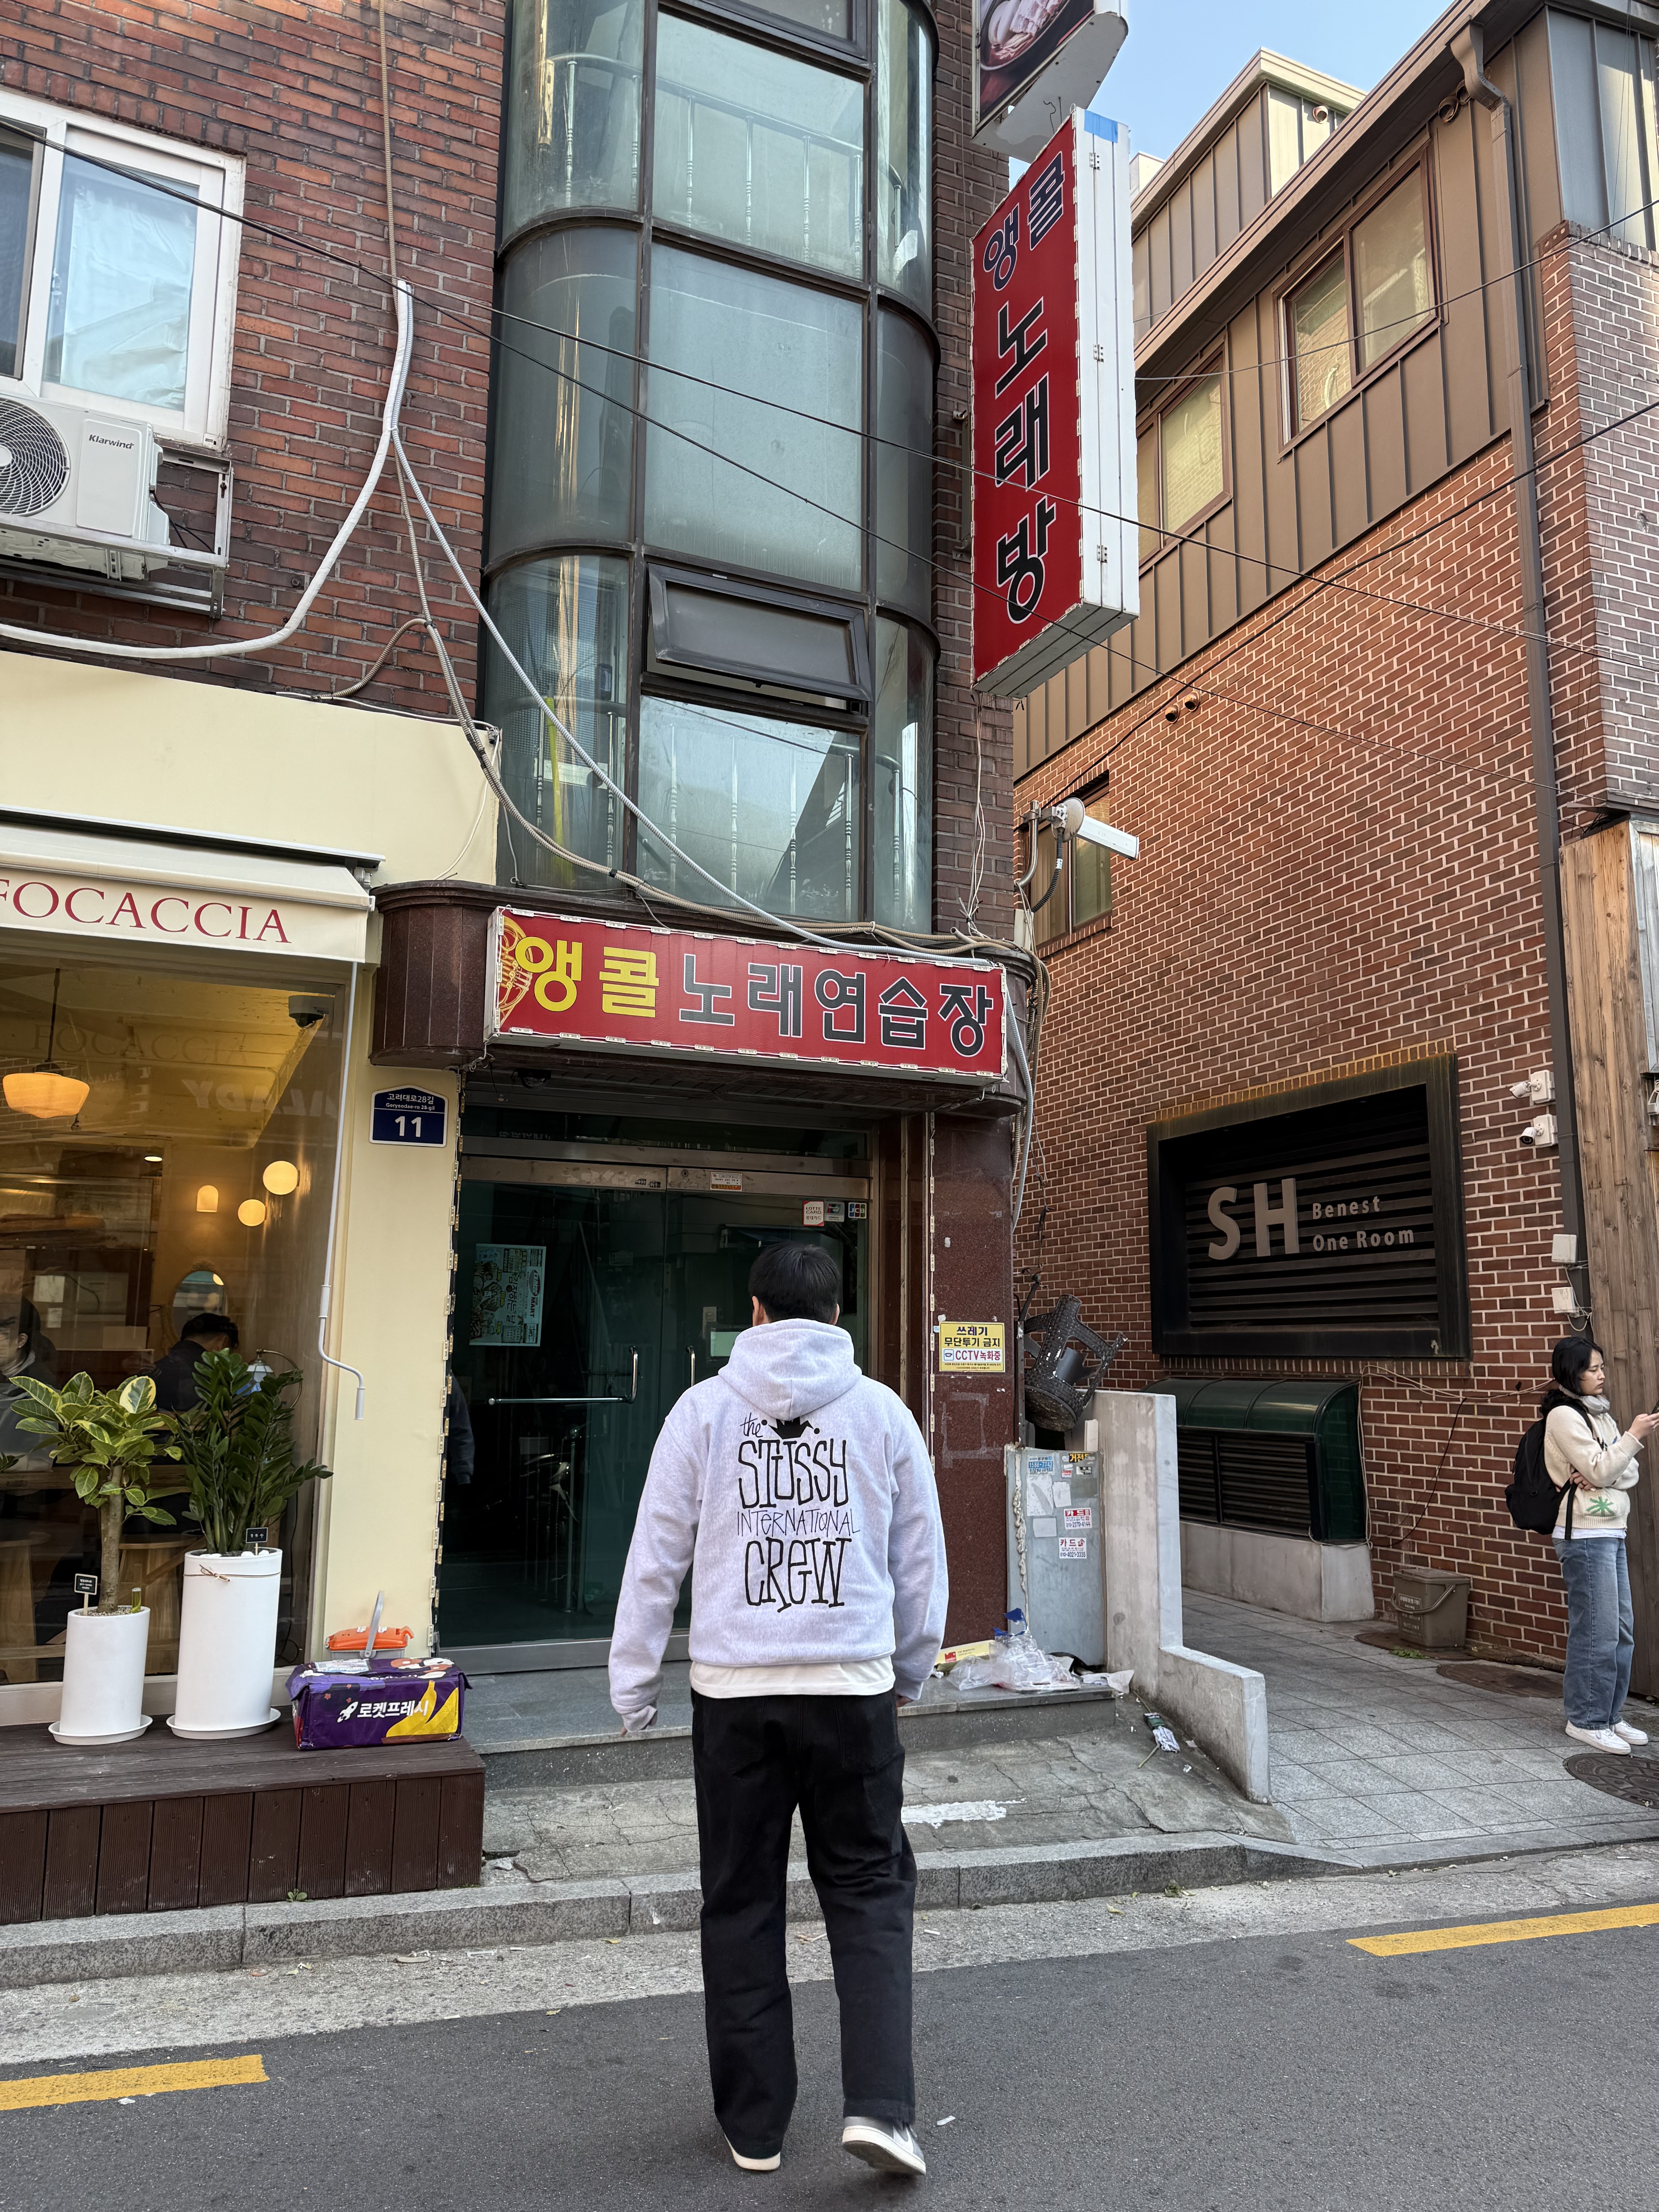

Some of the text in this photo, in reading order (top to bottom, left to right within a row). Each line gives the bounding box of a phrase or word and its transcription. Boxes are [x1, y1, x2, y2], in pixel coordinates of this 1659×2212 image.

[983, 150, 1065, 291] 앵콜
[89, 434, 134, 449] Klarwind
[994, 296, 1056, 624] 노래방
[515, 936, 994, 1058] 앵콜 노래연습장
[387, 1093, 434, 1104] 고려대로28길
[395, 1116, 422, 1137] 11
[1207, 1178, 1381, 1260] SH Benest
[1313, 1228, 1415, 1252] One Room
[944, 1337, 1000, 1347] 무단투기 금지
[957, 1326, 988, 1336] 쓰레기
[740, 1412, 763, 1438] the
[738, 1438, 848, 1509] STUSSY
[744, 1537, 852, 1613] CREW
[357, 1700, 429, 1718] 로켓프레시
